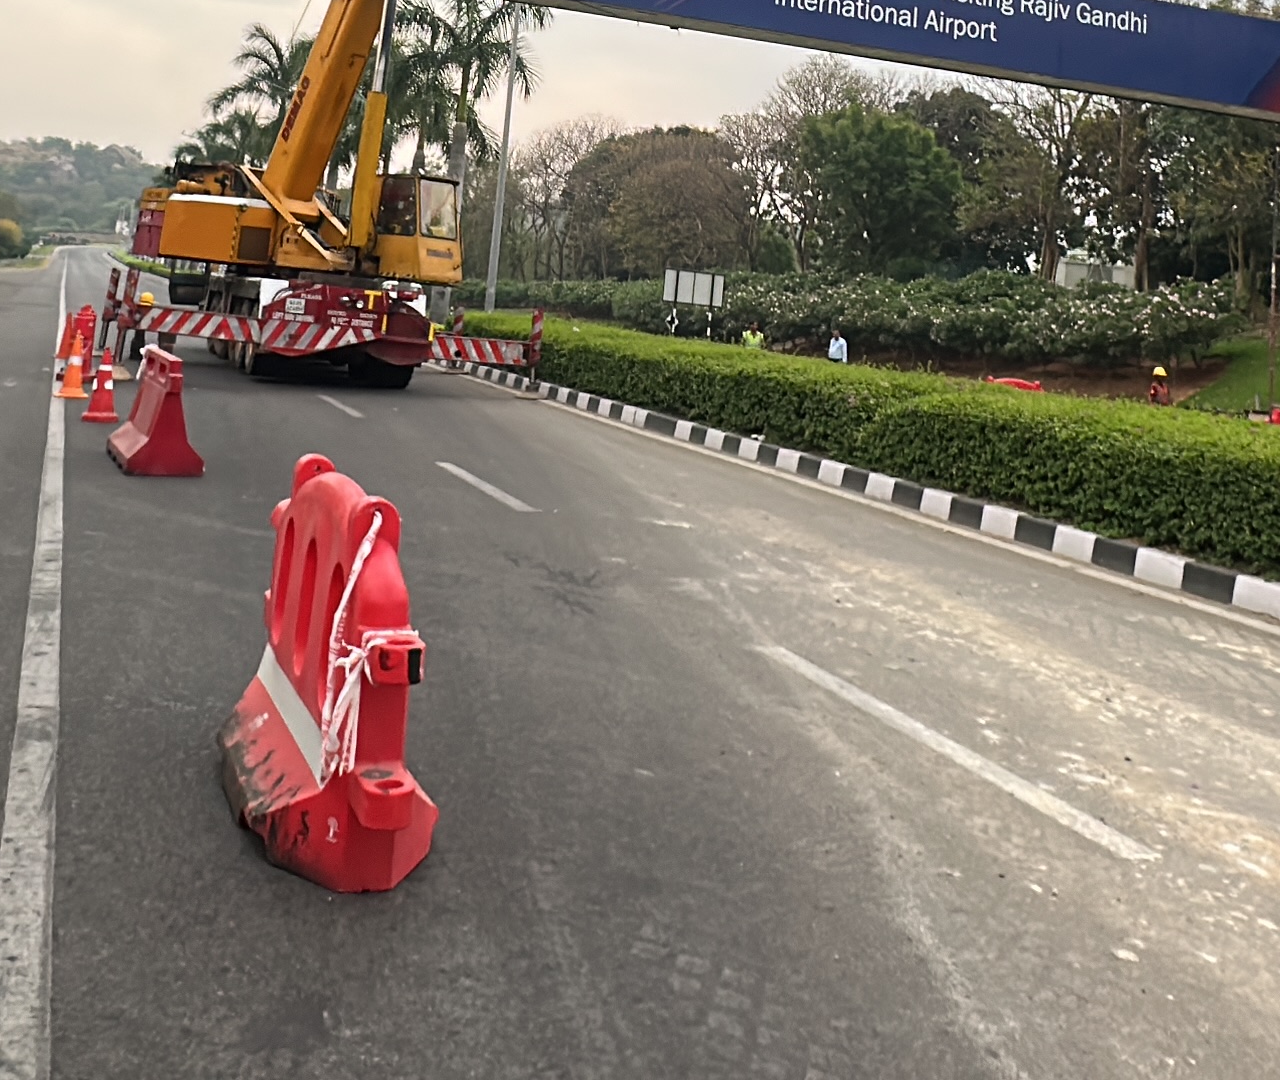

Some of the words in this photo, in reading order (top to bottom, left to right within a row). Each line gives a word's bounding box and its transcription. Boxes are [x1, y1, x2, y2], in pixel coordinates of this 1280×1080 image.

[923, 9, 998, 42] Airport
[1076, 2, 1148, 34] Gandhi
[281, 74, 312, 142] DEMAG
